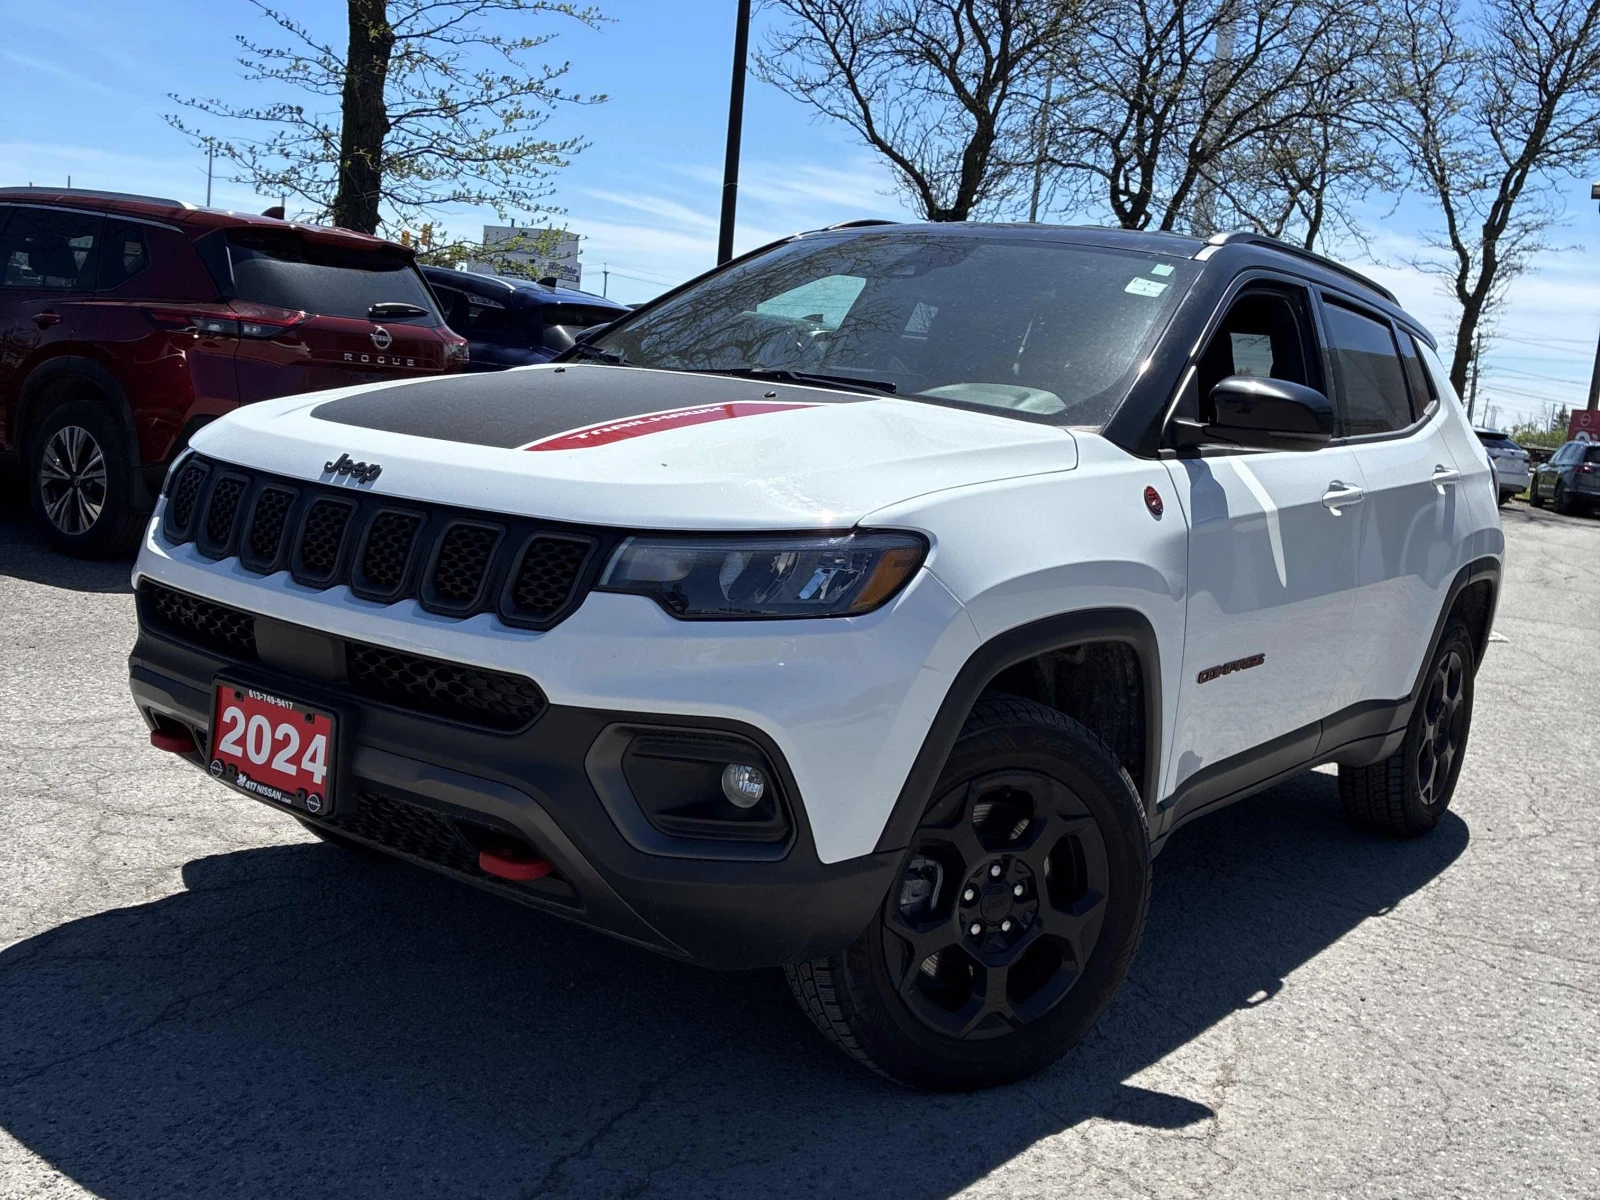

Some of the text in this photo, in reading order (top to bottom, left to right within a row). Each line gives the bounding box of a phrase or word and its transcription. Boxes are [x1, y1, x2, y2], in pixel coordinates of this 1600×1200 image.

[344, 352, 414, 367] ROGUE
[567, 406, 725, 440] TRAILHAWK
[324, 453, 382, 485] Jeep
[248, 689, 294, 710] 613-749-9417
[218, 706, 327, 785] 2024
[245, 780, 257, 792] 417
